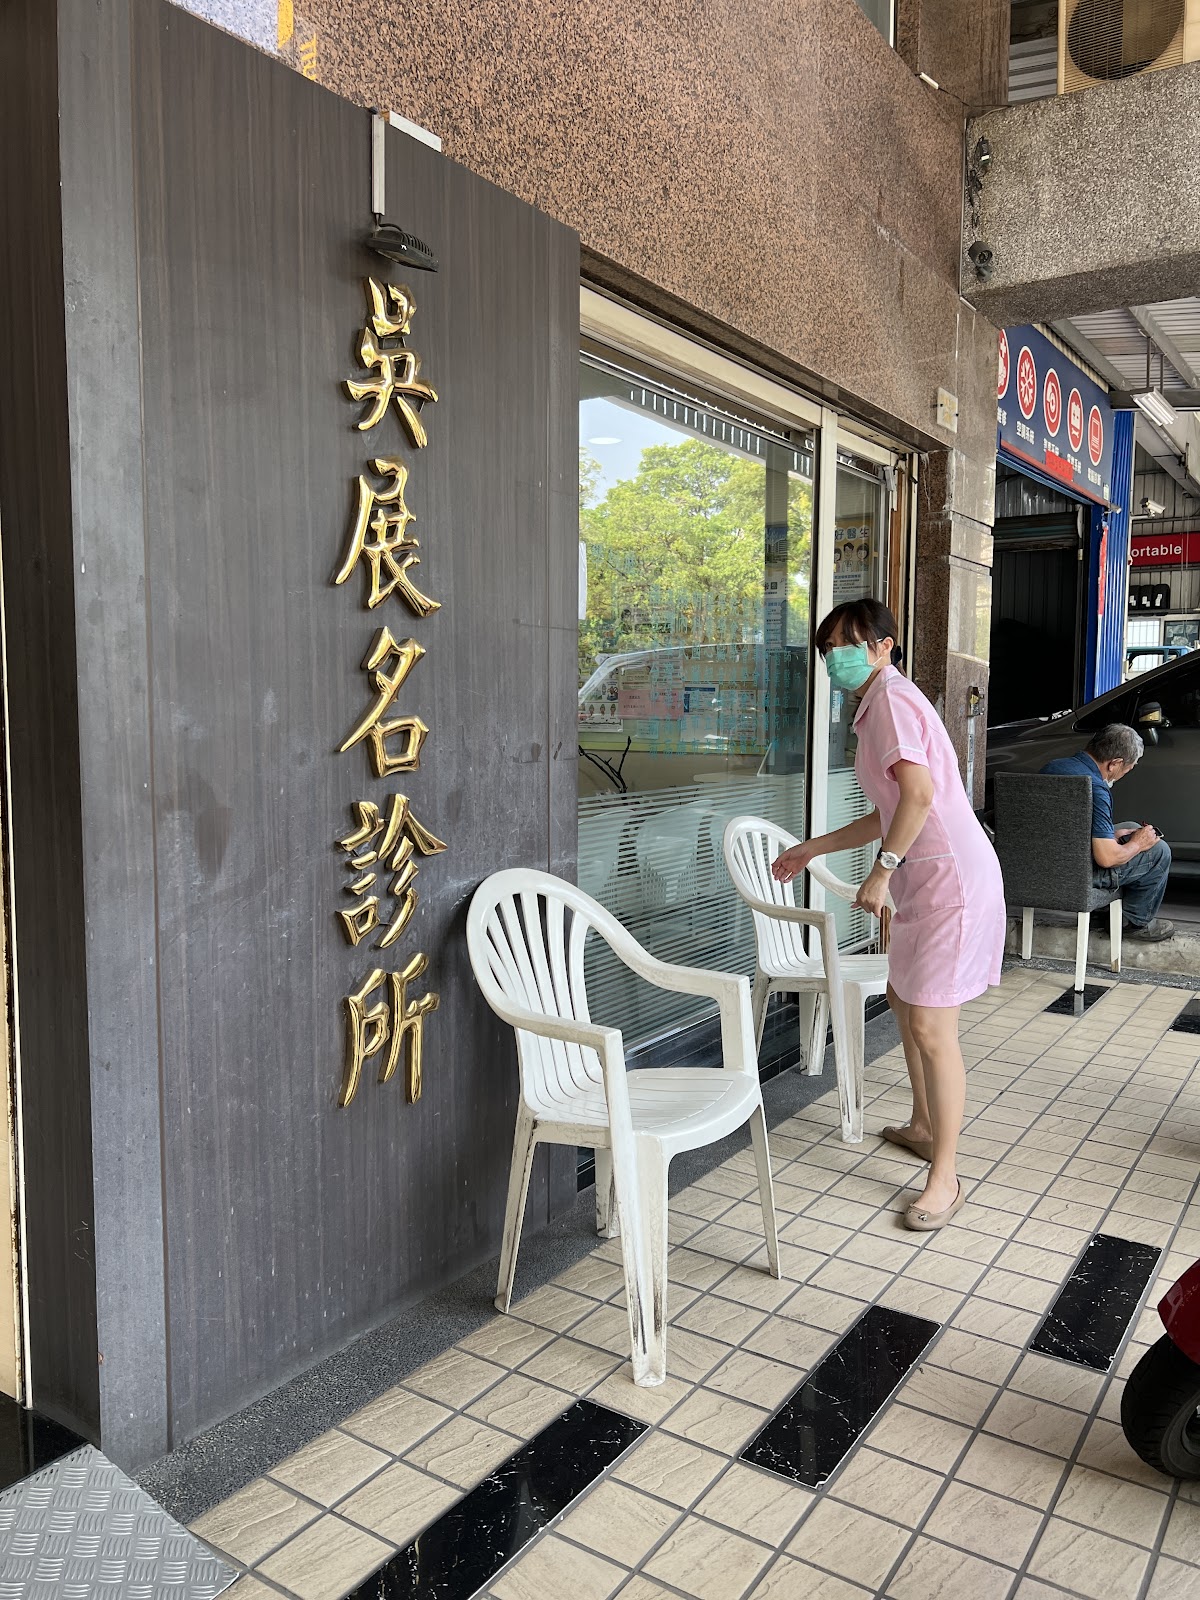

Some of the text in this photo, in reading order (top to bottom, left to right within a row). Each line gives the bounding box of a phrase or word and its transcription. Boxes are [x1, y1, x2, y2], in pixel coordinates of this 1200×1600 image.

[336, 275, 448, 1107] 吳展名診所
[1131, 543, 1182, 557] ortable
